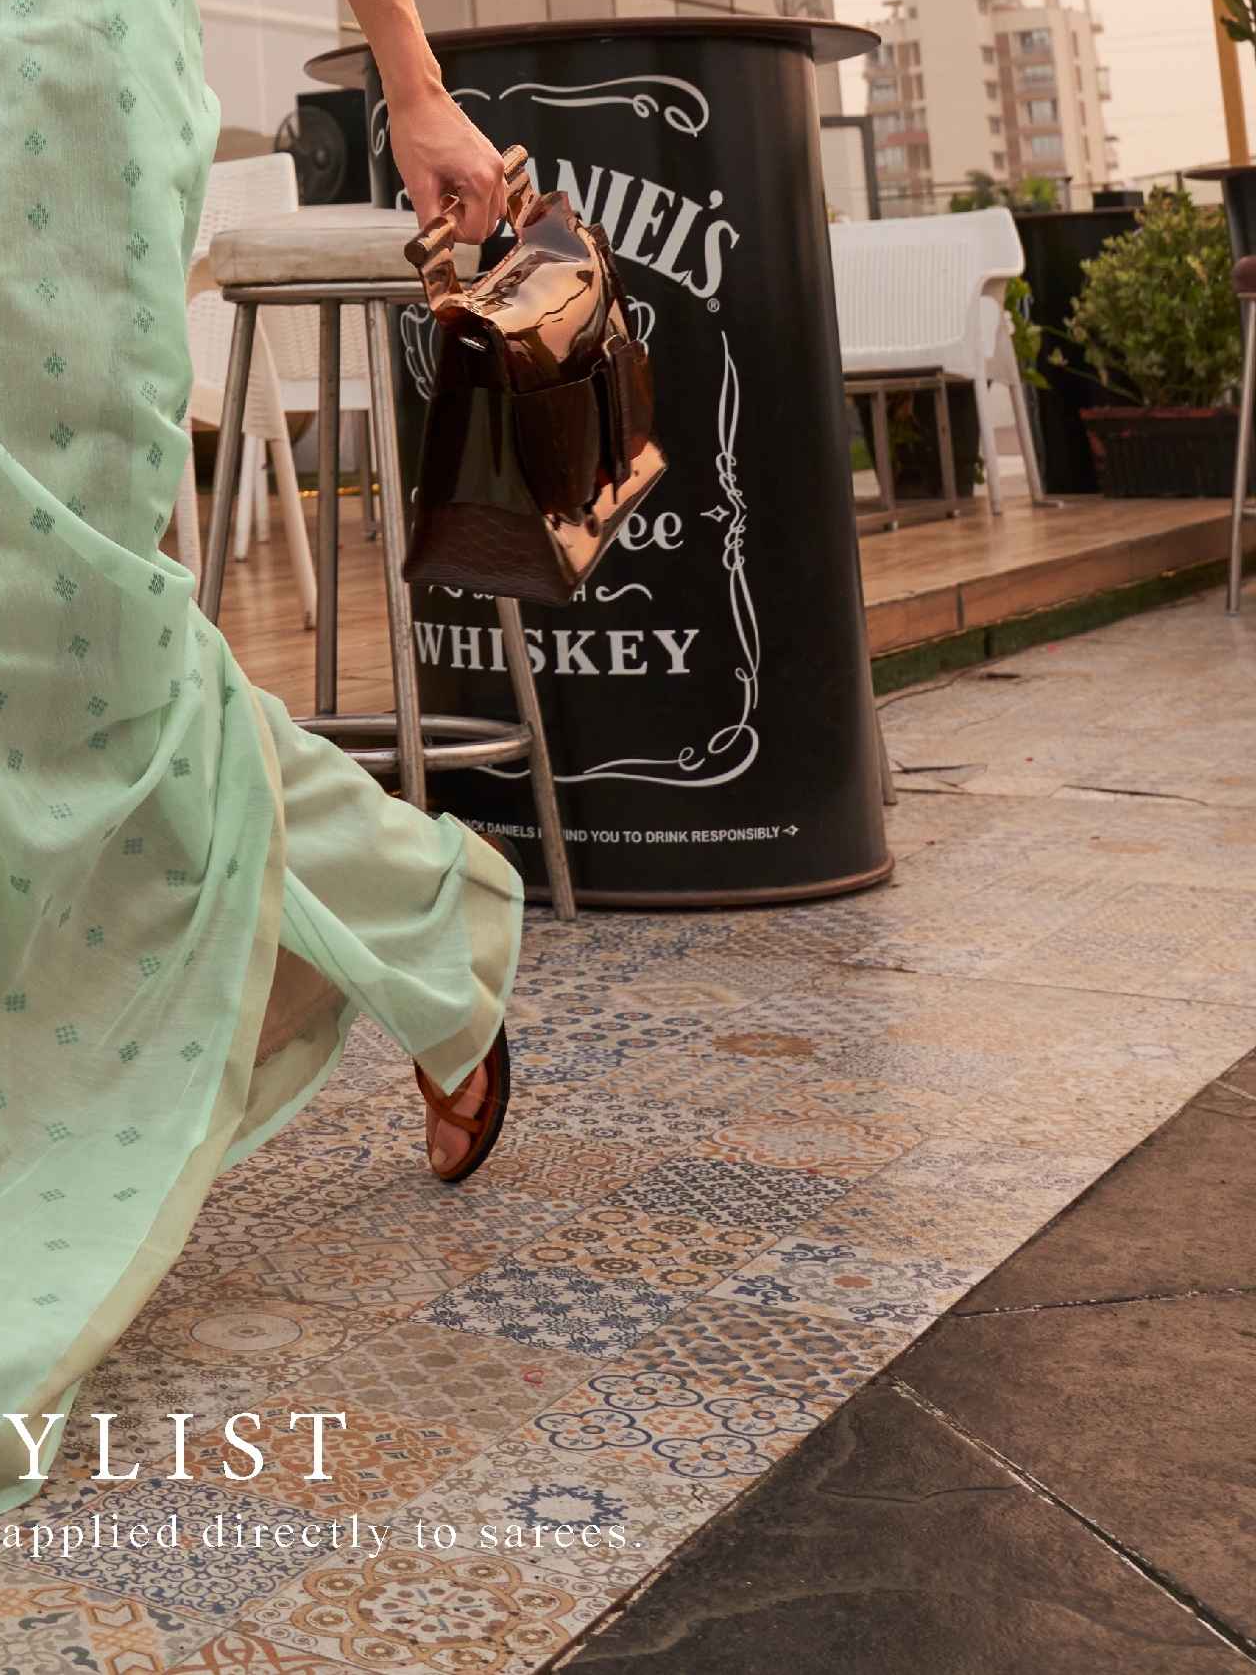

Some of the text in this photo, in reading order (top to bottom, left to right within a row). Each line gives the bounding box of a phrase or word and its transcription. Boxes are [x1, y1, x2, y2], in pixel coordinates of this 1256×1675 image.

[414, 621, 700, 676] WHISKEY
[487, 822, 535, 838] DANIELS
[591, 830, 621, 843] YOU
[623, 830, 642, 843] TO
[646, 830, 689, 843] DRINK
[692, 826, 781, 843] RESPONSIBLY
